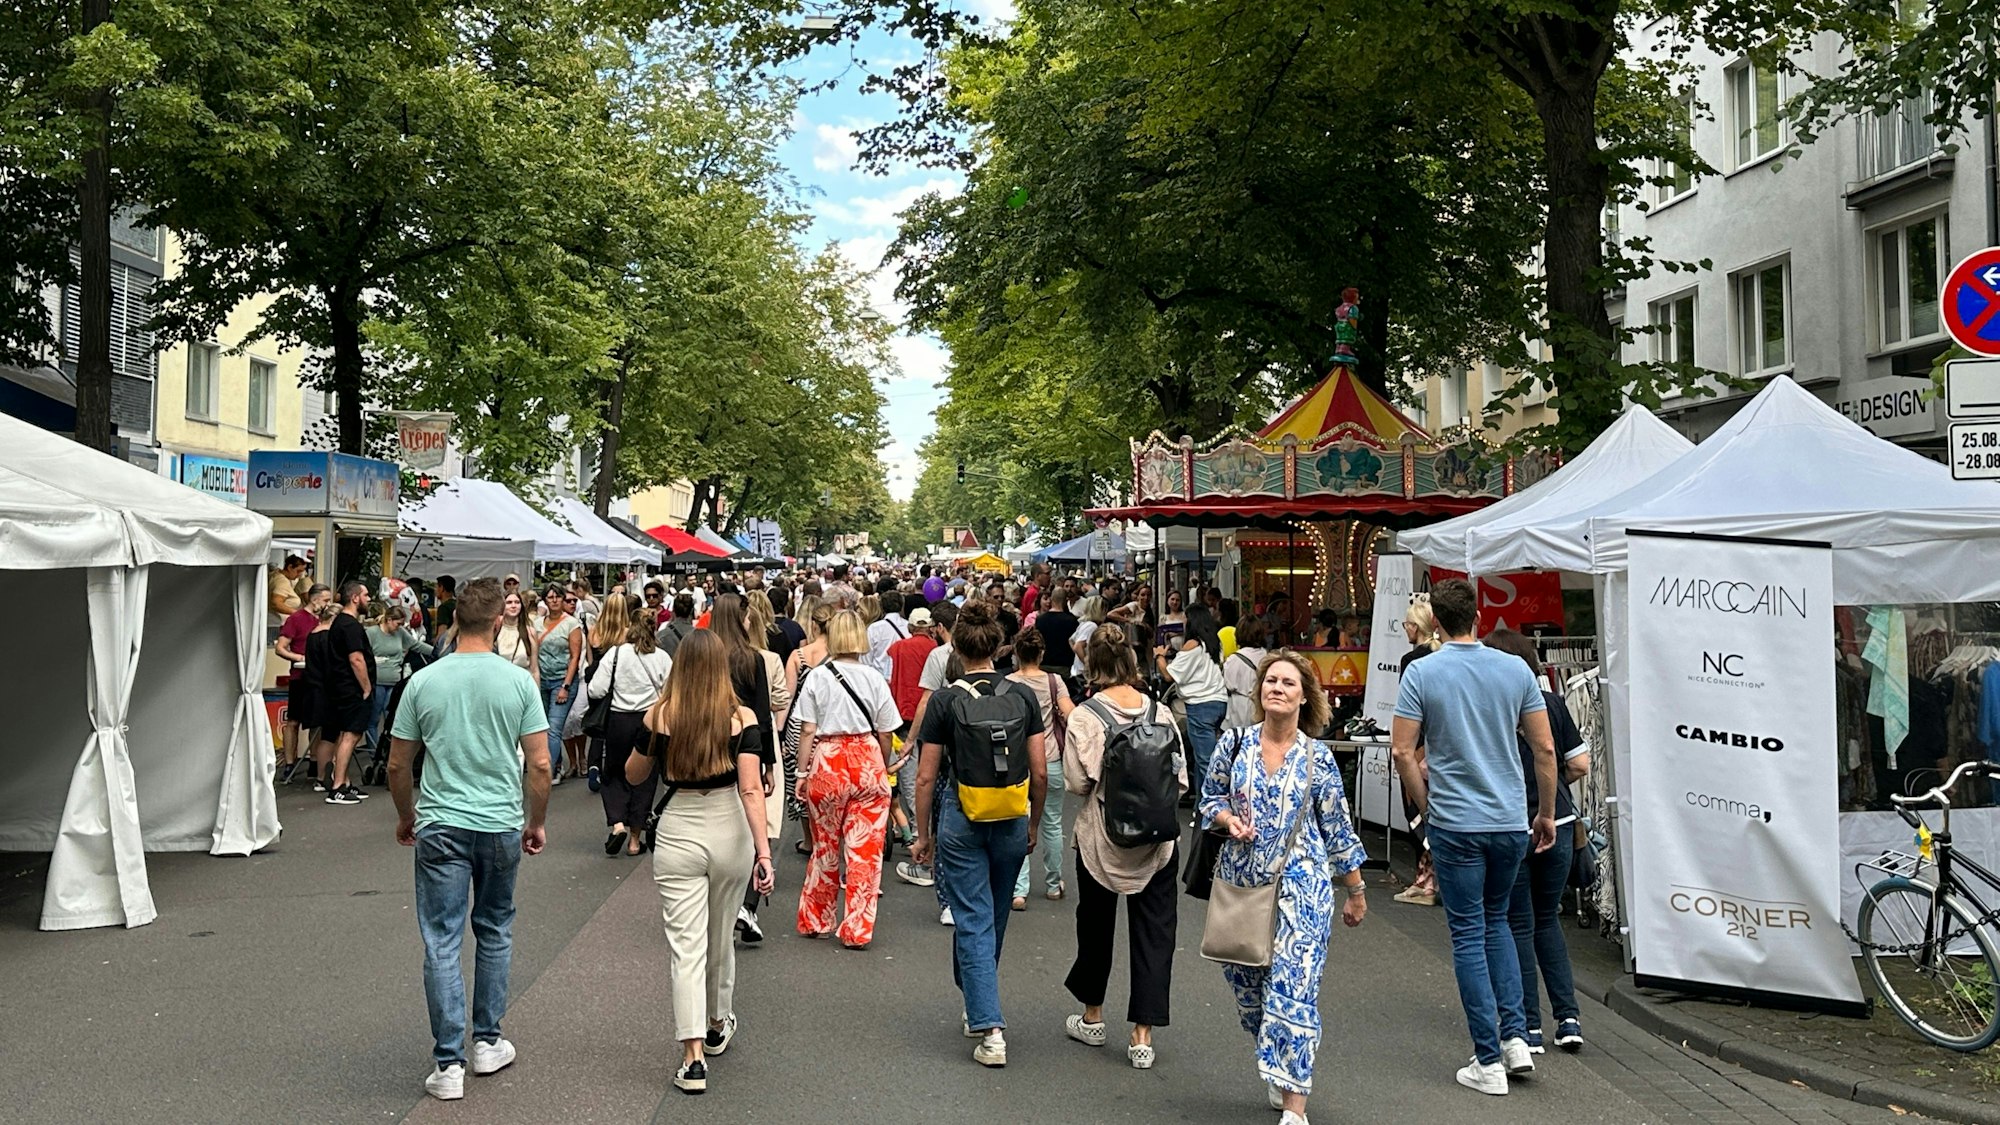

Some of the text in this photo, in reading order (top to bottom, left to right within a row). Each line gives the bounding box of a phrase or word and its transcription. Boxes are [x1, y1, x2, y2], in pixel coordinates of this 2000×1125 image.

[1861, 388, 1926, 422] DESIGN
[400, 428, 446, 452] Crêpes
[201, 465, 248, 494] MOBILEKL
[255, 471, 323, 496] Crêperie
[1388, 619, 1398, 632] NC
[1703, 651, 1744, 677] NC
[1676, 724, 1784, 752] CAMBIO
[1686, 791, 1772, 823] comma,
[1670, 893, 1812, 929] CORNER
[1726, 922, 1758, 940] 212
